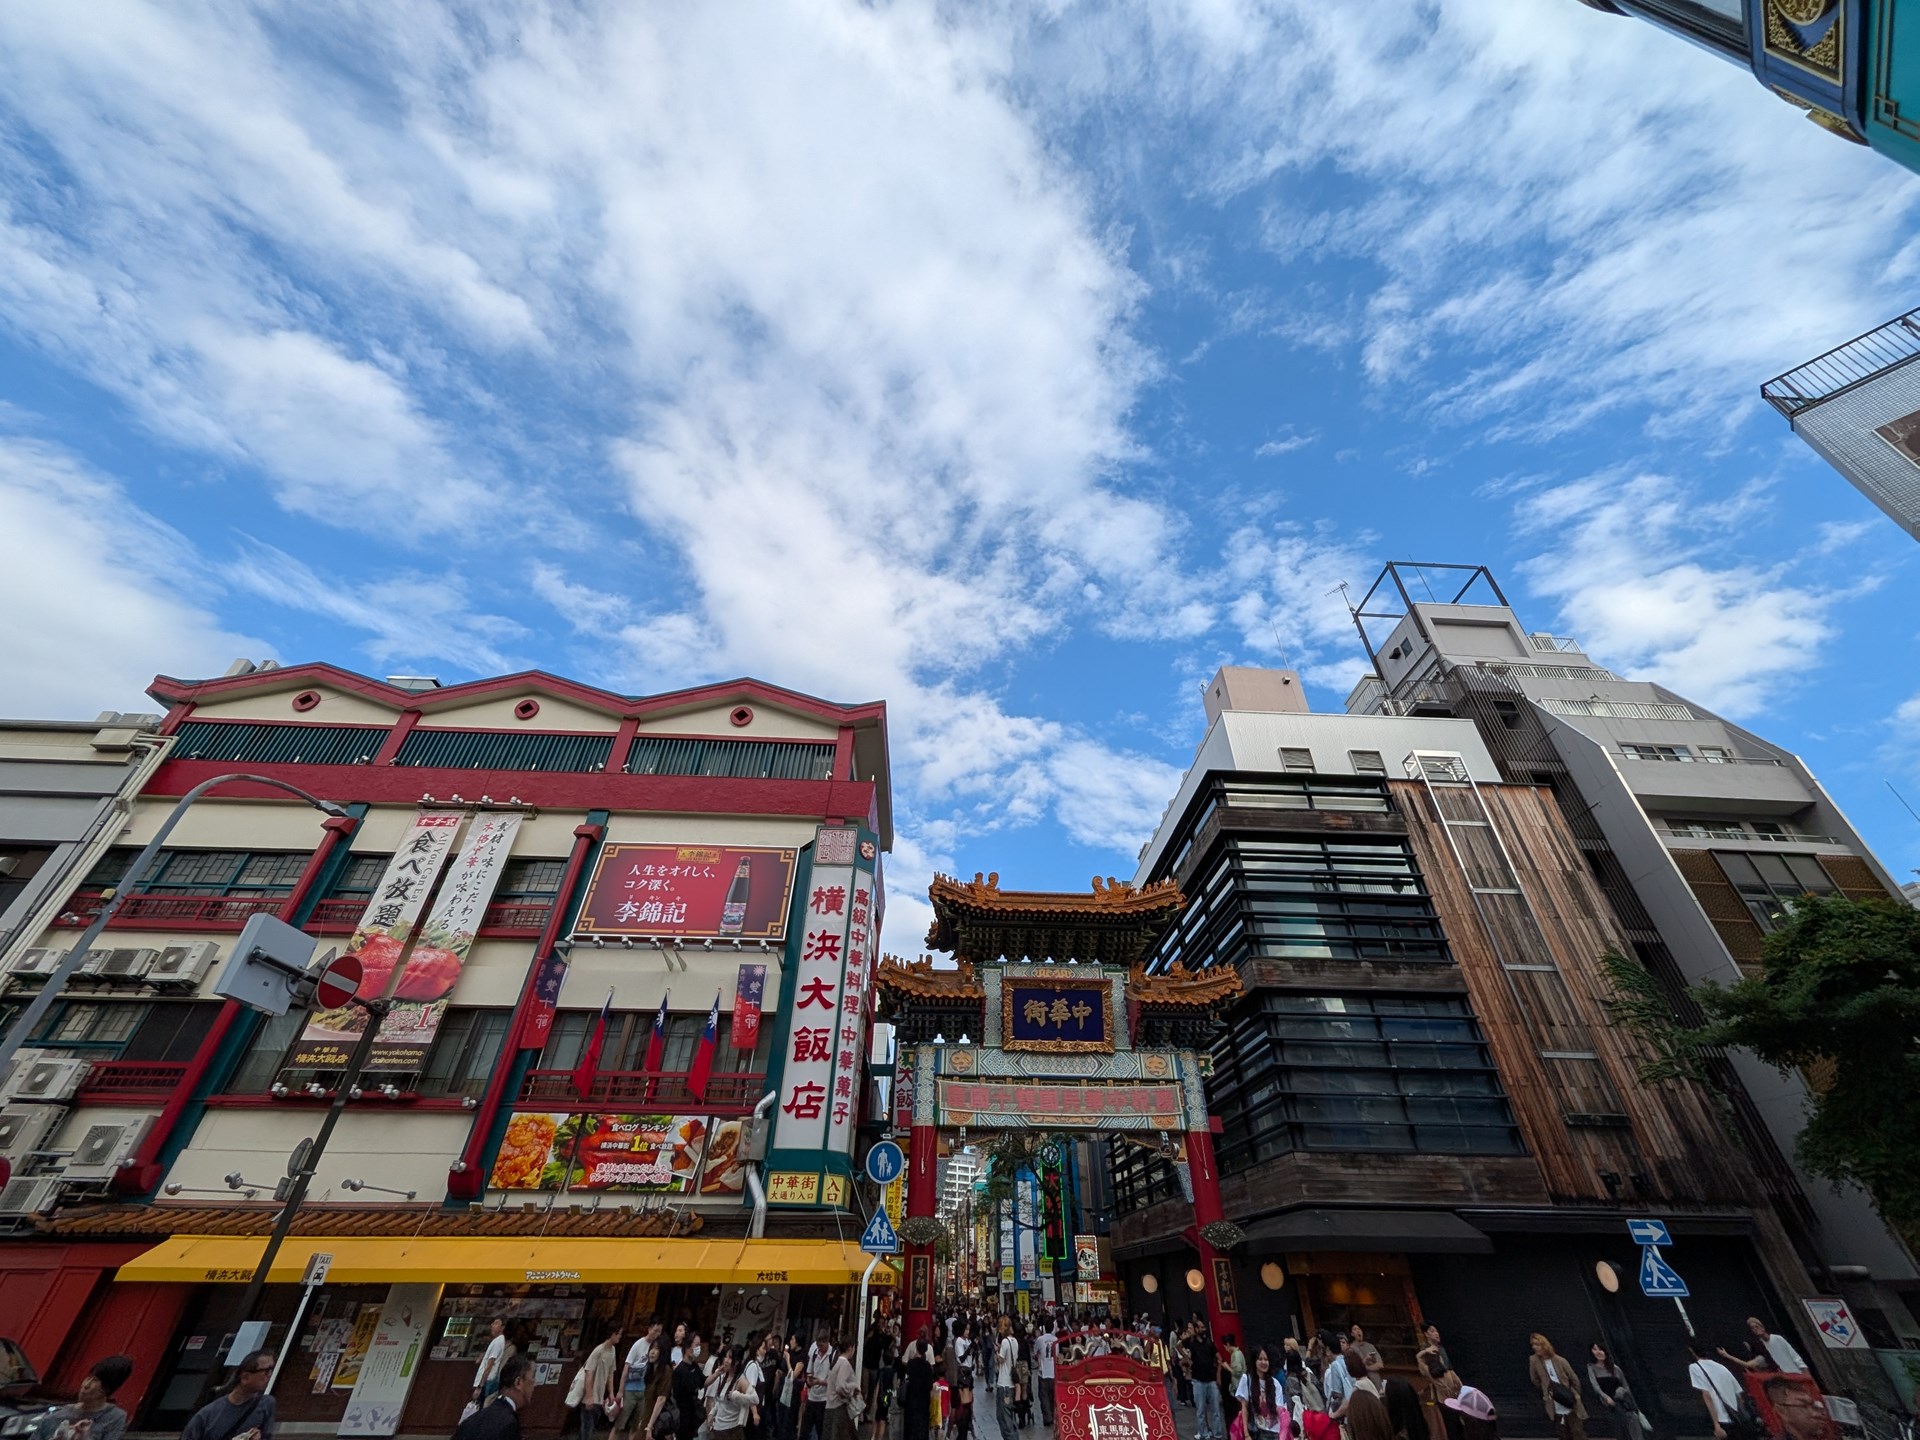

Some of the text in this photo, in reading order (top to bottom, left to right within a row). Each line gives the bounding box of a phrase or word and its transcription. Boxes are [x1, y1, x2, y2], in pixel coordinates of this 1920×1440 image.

[419, 818, 456, 827] オーダー式
[409, 832, 449, 903] All You Can Eat
[628, 864, 716, 878] 人生をオイしく、
[371, 831, 437, 928] 食べ放題
[440, 822, 494, 930] 本格中華が味わえる
[624, 879, 675, 892] コク深く。
[614, 901, 688, 924] 李錦記
[782, 885, 847, 1121] 横浜大飯店
[833, 887, 871, 1126] 高級中華料理・中華菓子
[1023, 998, 1093, 1031] 中華街
[295, 1053, 349, 1064] 横浜大飯店
[371, 1049, 424, 1057] www.yokohama-
[370, 1057, 419, 1065] daihanten.com
[895, 1067, 914, 1132] 大飯
[611, 1123, 675, 1133] 食べログ ランキング
[630, 1135, 649, 1152] 1位
[772, 1175, 817, 1190] 中華街
[826, 1176, 841, 1202] 入口
[770, 1190, 814, 1201] 大通り入口
[319, 1256, 332, 1264] TAXI
[205, 1269, 254, 1281] 横浜大飯
